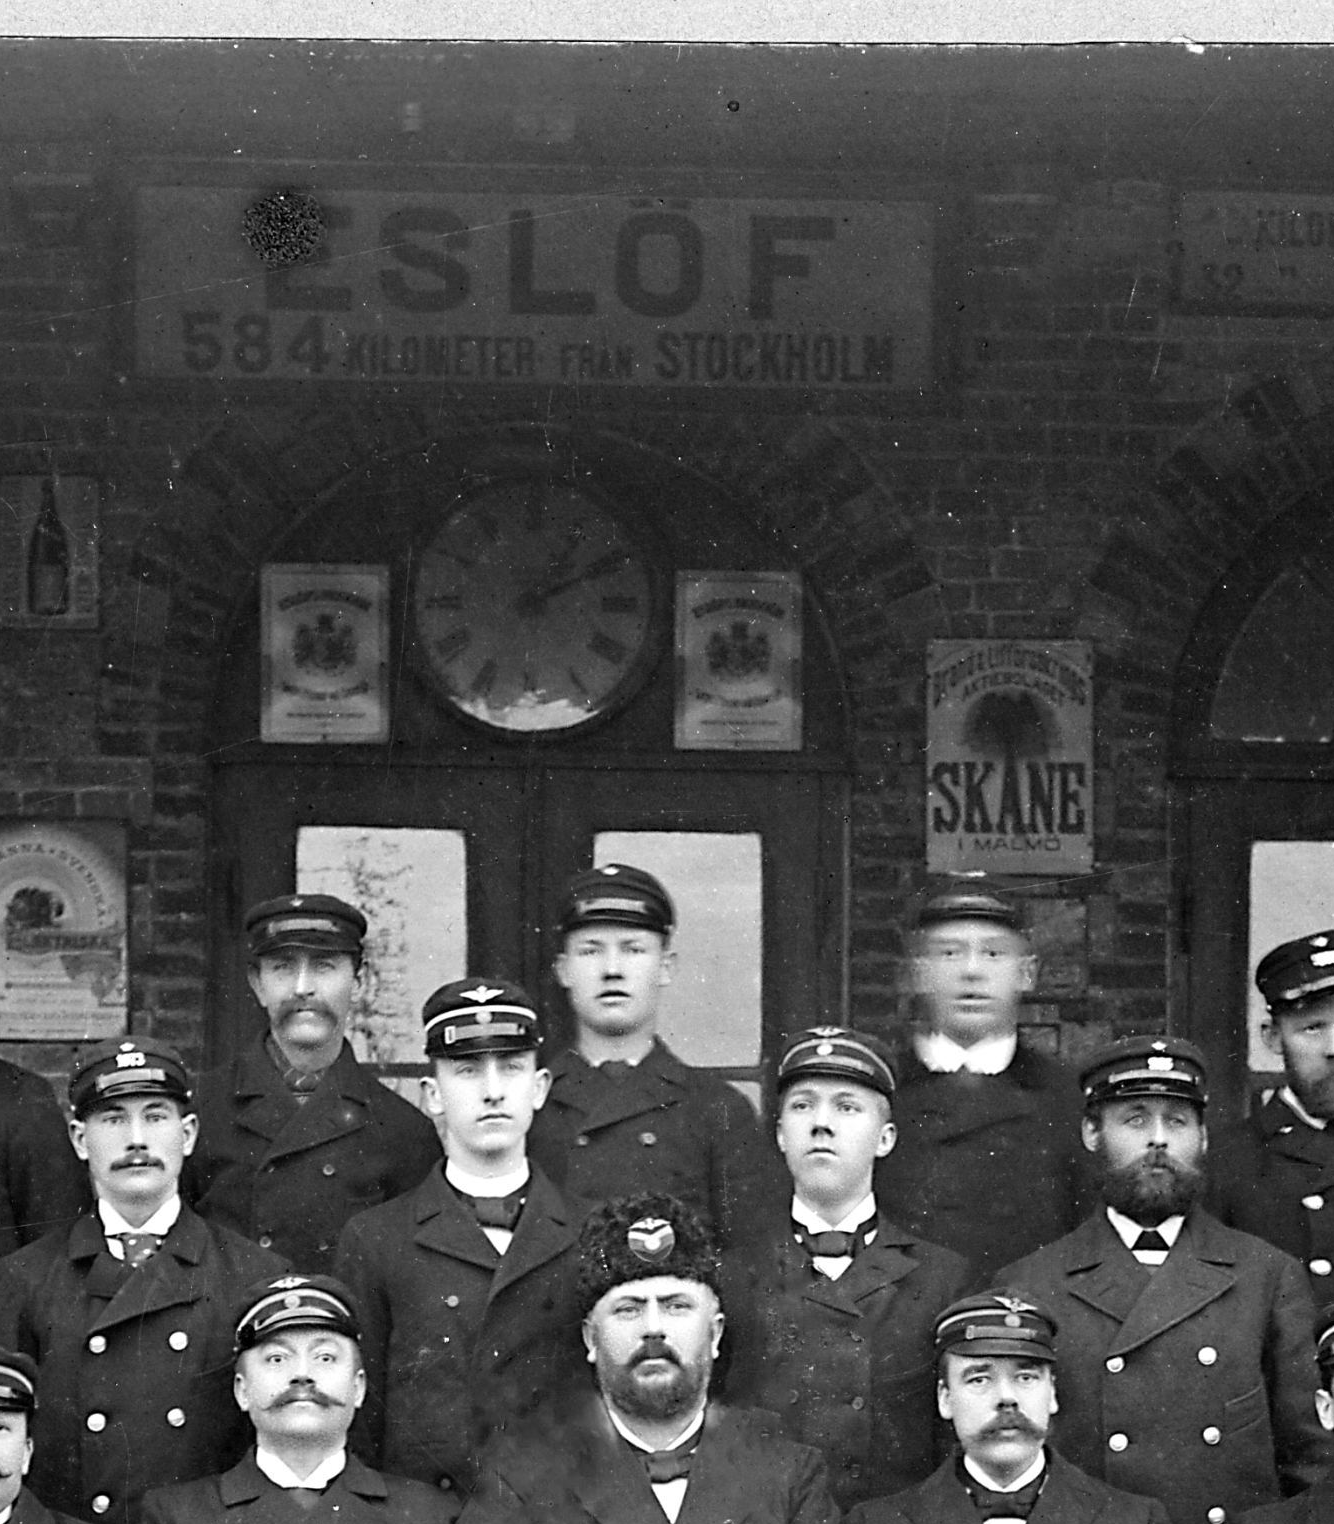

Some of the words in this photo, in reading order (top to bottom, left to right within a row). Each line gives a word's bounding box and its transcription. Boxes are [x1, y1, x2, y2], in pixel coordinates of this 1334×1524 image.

[181, 309, 332, 374] 584
[347, 333, 535, 377] KILOMETER
[654, 331, 894, 384] STOCKHOLM
